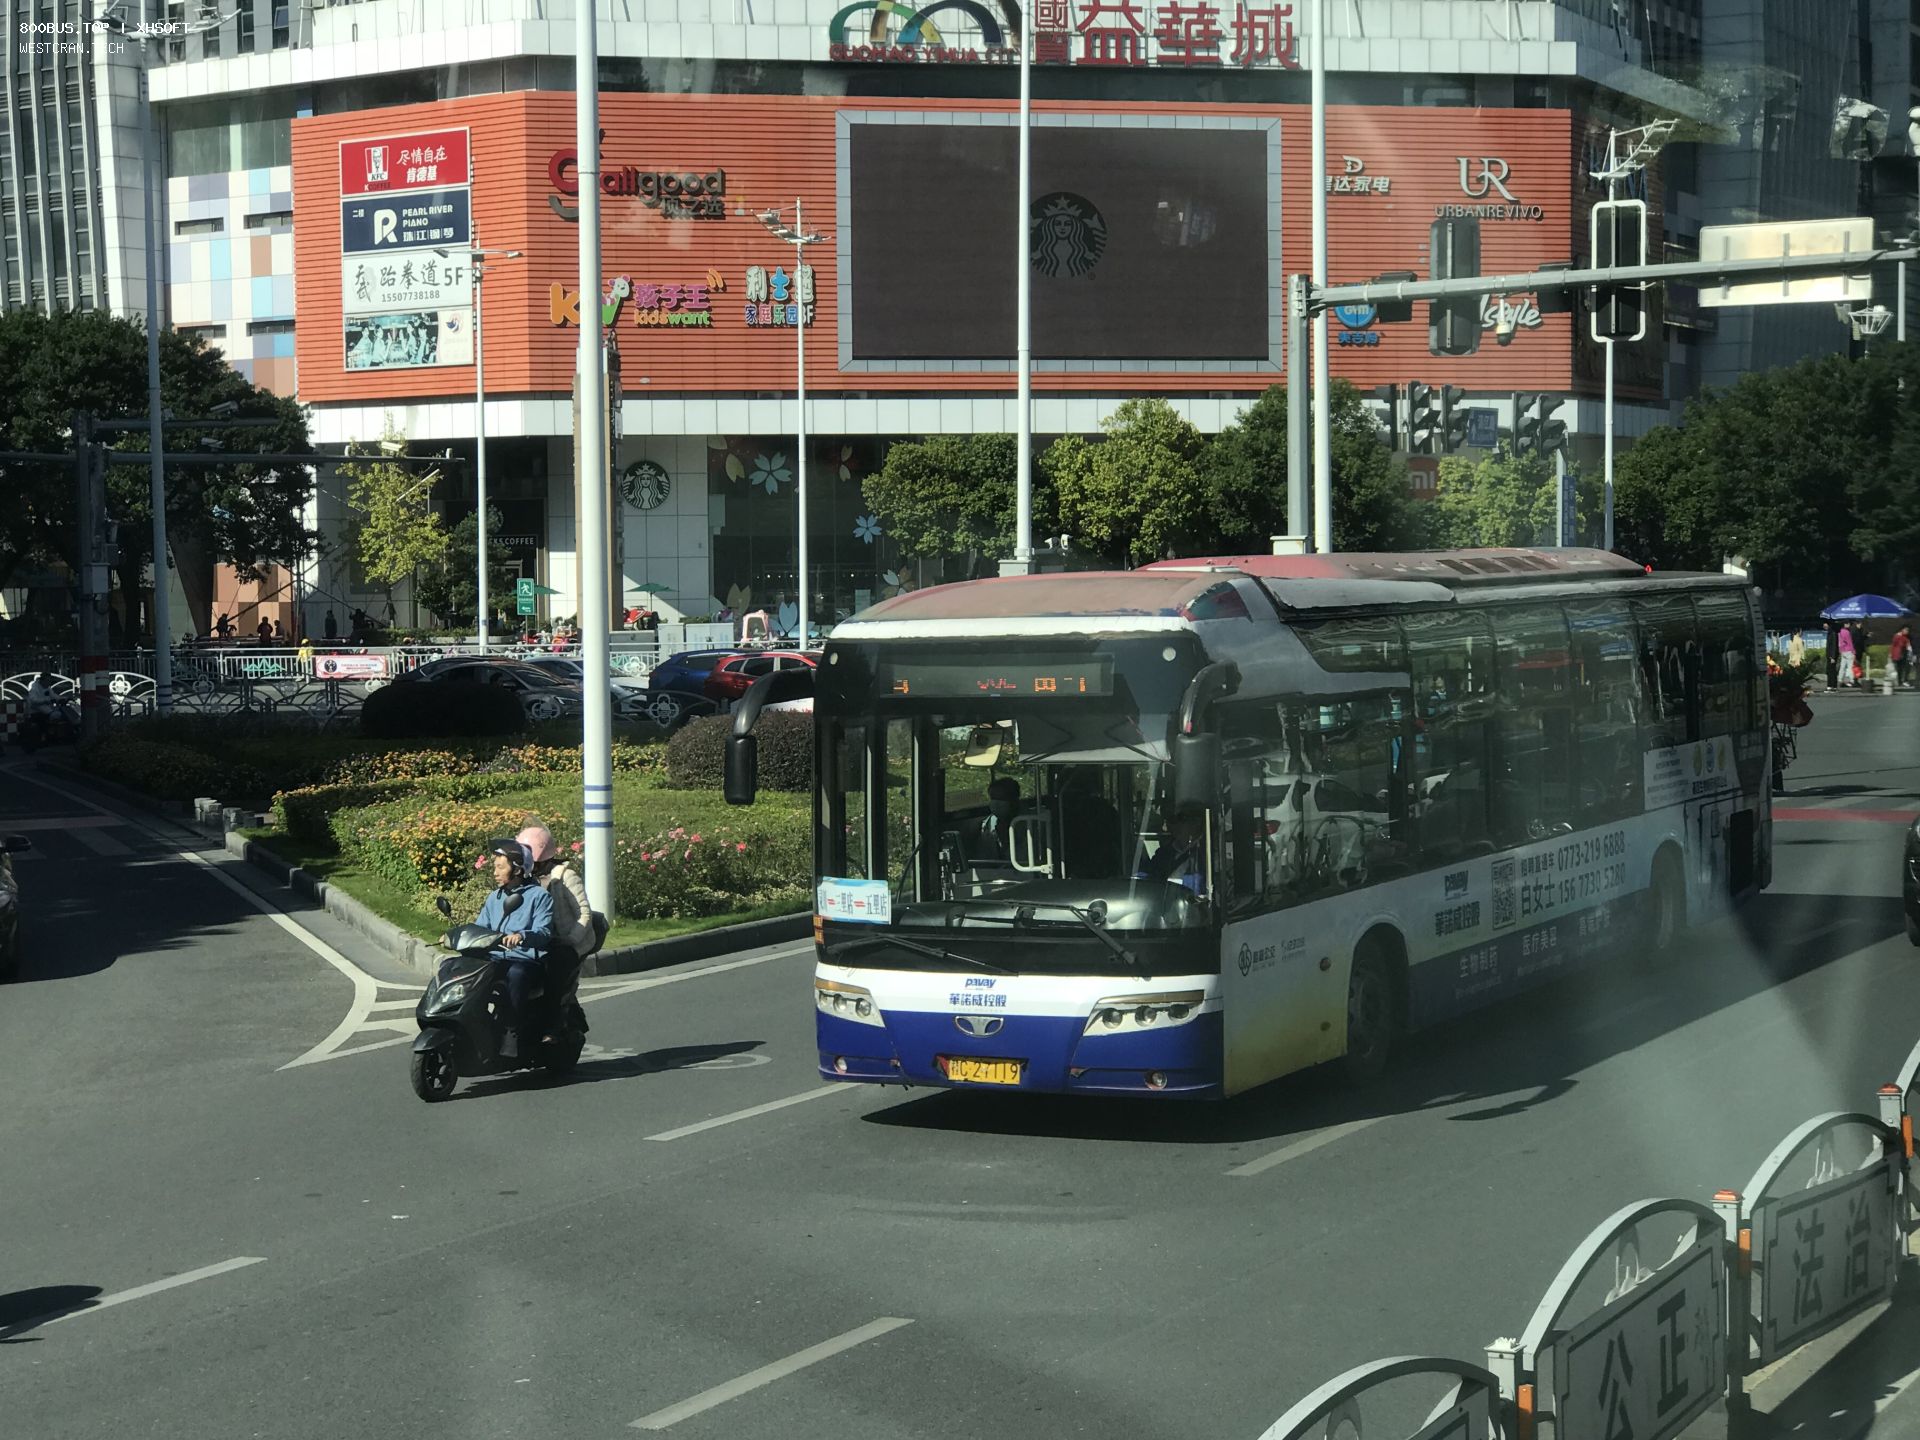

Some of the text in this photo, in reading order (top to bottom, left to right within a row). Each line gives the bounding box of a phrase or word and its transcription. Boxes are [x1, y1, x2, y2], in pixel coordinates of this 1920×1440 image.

[396, 145, 448, 165] 尽情自在
[371, 173, 385, 181] KFC
[406, 165, 438, 183] 肯德基
[1456, 157, 1519, 201] UR
[599, 166, 723, 207] allgood
[402, 204, 453, 217] PEARL RIVER
[402, 217, 429, 228] PIANO
[382, 289, 440, 303] 15507738188
[634, 284, 710, 309] 孩子王
[633, 309, 711, 325] kidswant
[504, 537, 534, 545] COFFEE
[1558, 830, 1626, 872] 0773-219 6888
[1521, 872, 1555, 918] 白女士
[1559, 876, 1576, 905] 156
[1793, 1189, 1871, 1325] 法治
[1598, 1287, 1690, 1440] 公正
